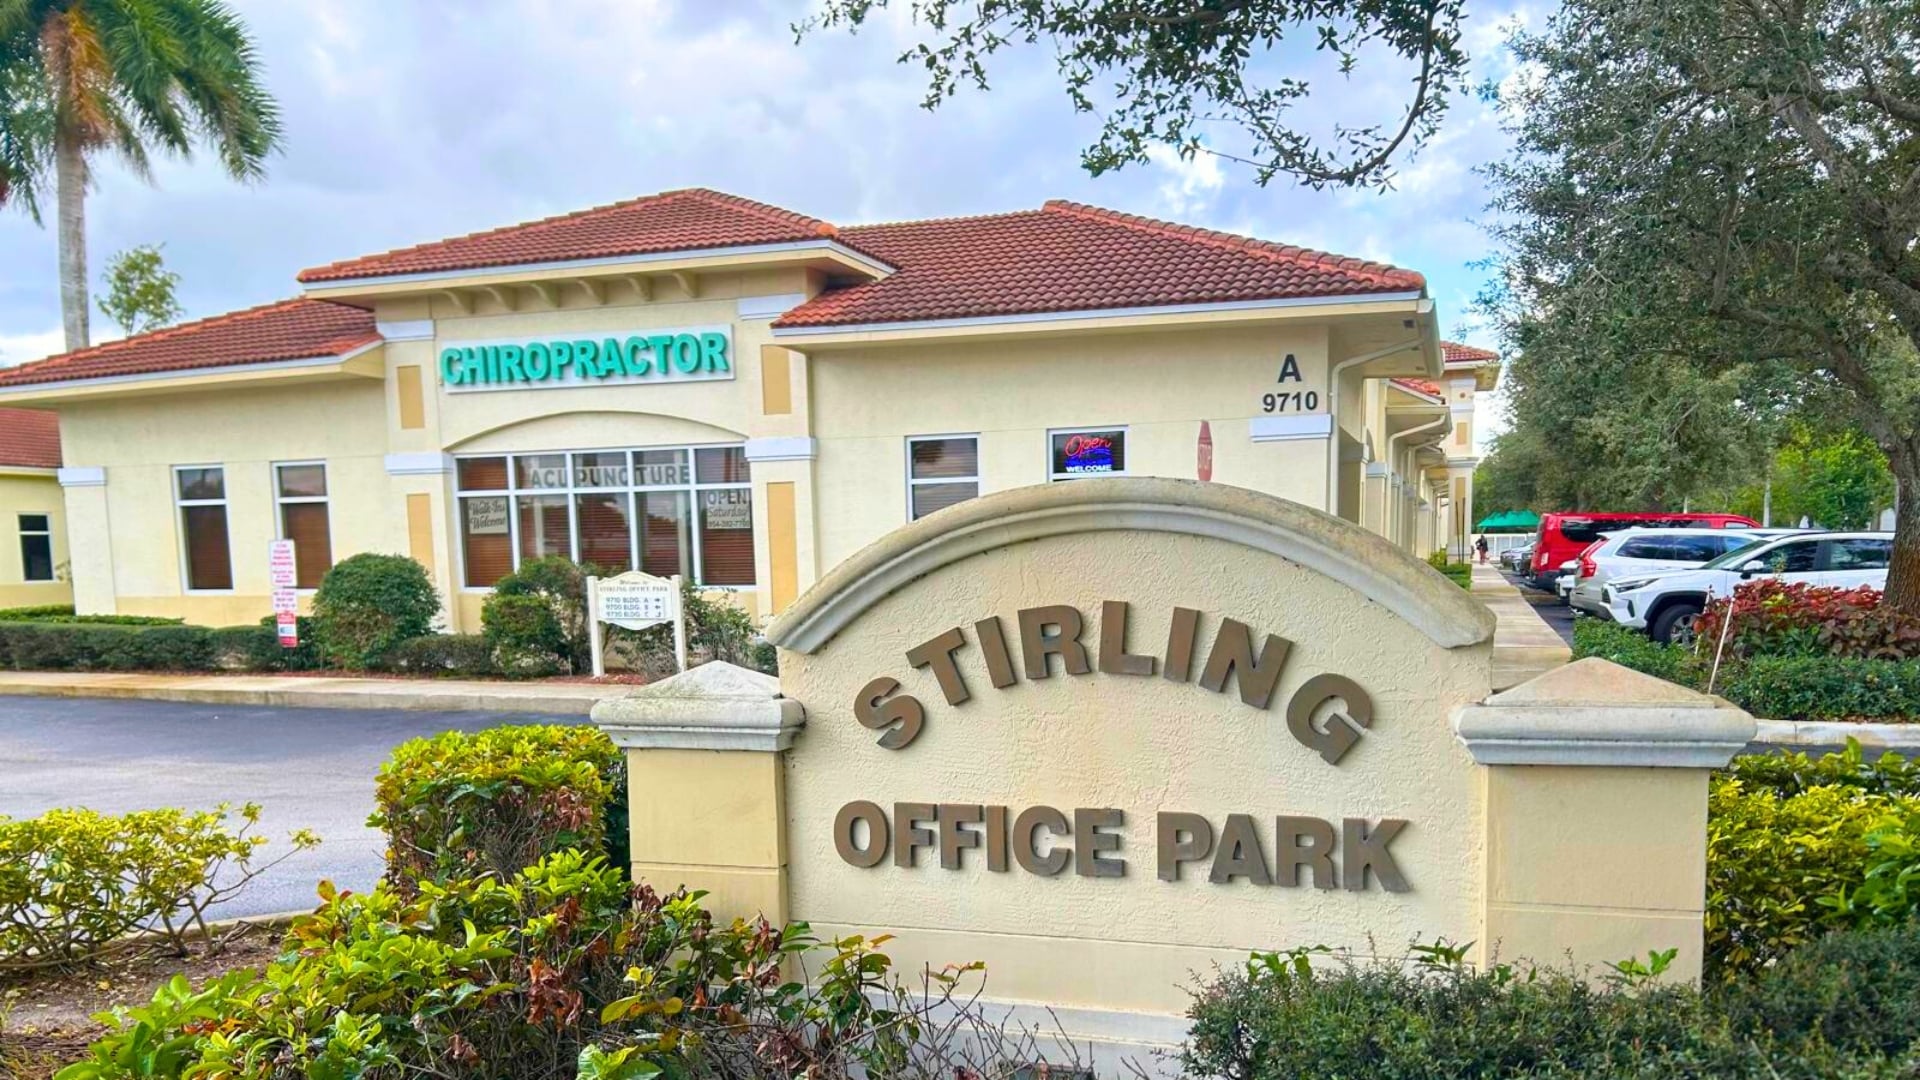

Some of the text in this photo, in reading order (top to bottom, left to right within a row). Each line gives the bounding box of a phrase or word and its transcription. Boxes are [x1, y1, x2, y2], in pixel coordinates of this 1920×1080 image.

[440, 332, 729, 385] CHIROPRACTOR
[1277, 353, 1302, 383] A
[1262, 391, 1318, 413] 9710
[1065, 434, 1113, 457] Open
[530, 464, 691, 489] ACUPUNCTURE
[1065, 464, 1112, 473] WELCOME
[707, 488, 747, 505] OPEN
[853, 600, 1373, 766] STIRLING
[833, 800, 1412, 893] OFFICE PARK
